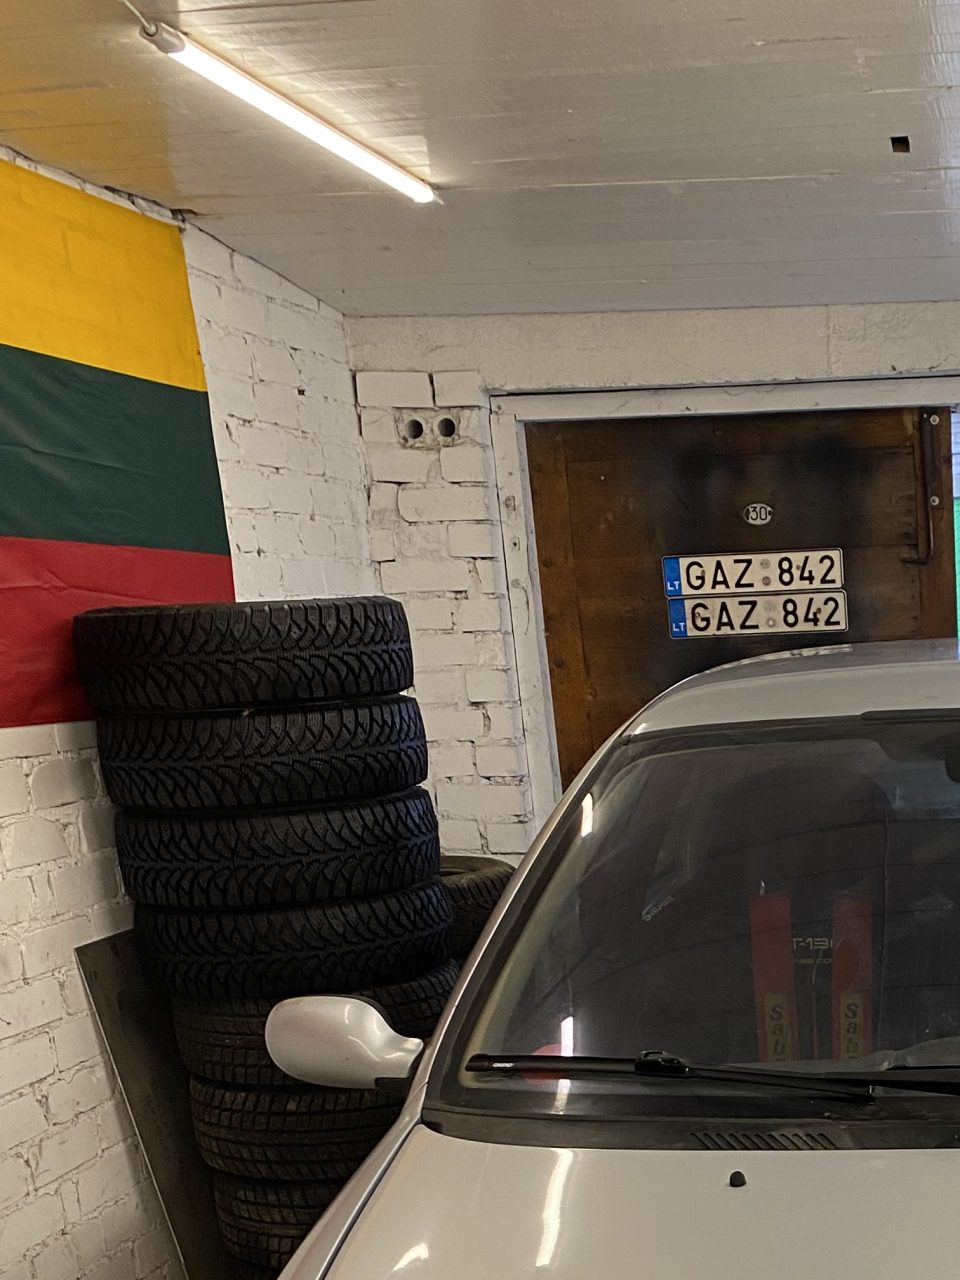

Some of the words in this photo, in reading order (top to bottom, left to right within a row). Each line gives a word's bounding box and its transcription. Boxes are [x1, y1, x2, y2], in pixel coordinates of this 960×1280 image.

[750, 506, 768, 521] 30
[667, 580, 681, 591] LT
[685, 558, 755, 591] GAZ
[777, 554, 837, 587] 842
[672, 622, 686, 632] LT
[690, 600, 760, 632] GAZ
[782, 596, 841, 628] 842
[769, 1004, 788, 1061] Sab
[844, 1002, 859, 1059] Sab
